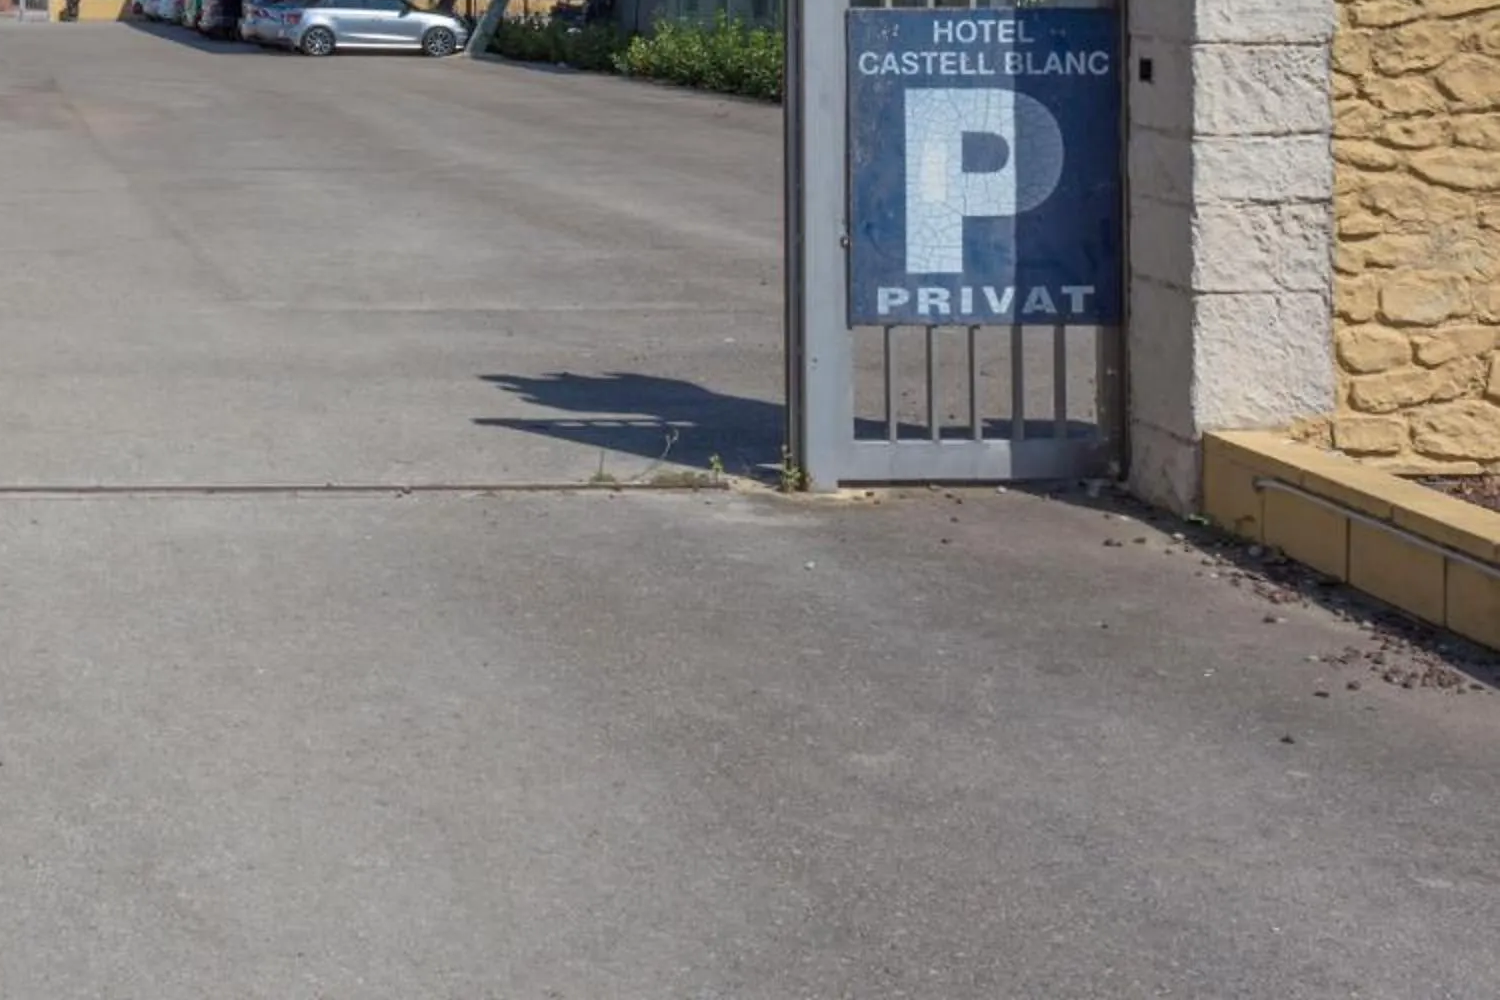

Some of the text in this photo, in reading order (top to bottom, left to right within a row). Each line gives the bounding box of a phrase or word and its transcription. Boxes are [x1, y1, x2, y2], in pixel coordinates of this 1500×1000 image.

[933, 19, 1035, 44] HOTEL
[857, 51, 1110, 76] CASTELL BLANC
[904, 87, 1065, 274] P
[876, 285, 1096, 315] PRIVAT
